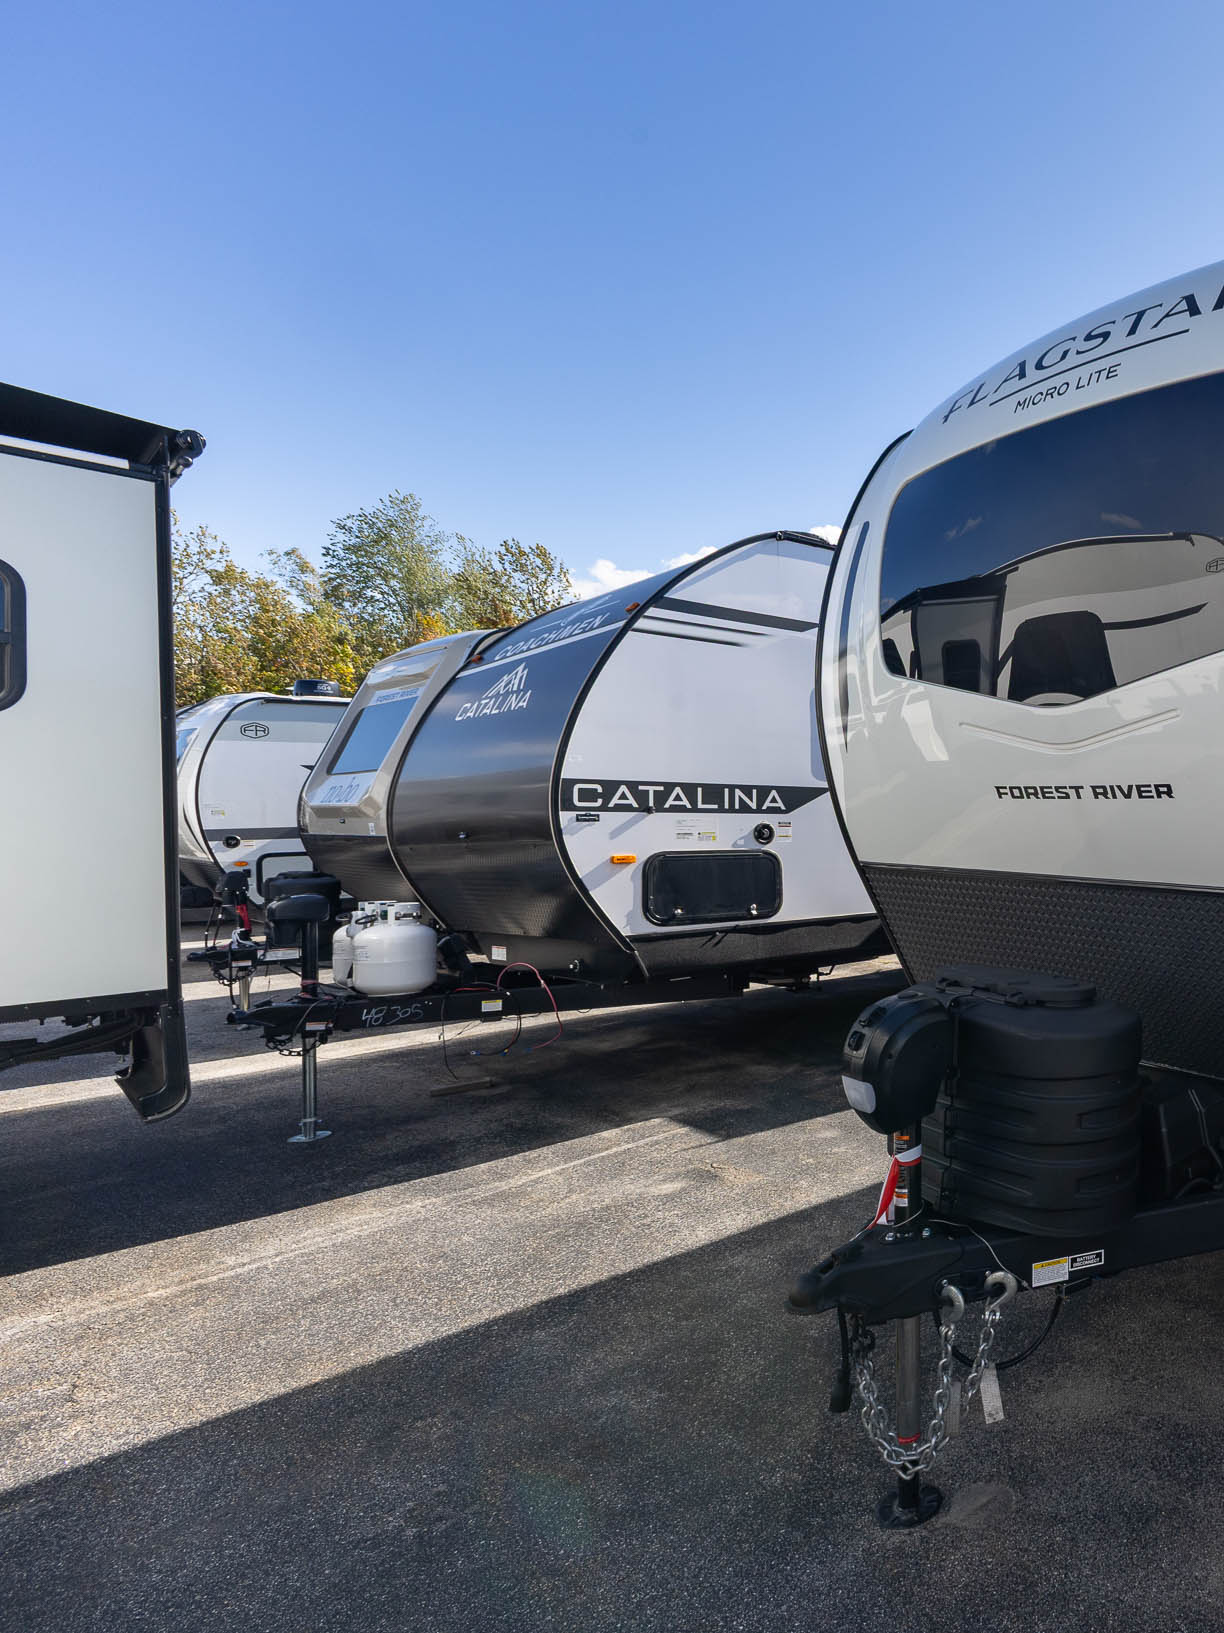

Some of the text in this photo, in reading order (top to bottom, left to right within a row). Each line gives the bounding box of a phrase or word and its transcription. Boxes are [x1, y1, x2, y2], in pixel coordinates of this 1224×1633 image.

[1013, 363, 1122, 414] MICRO LITE
[494, 612, 610, 660] COACHMEN
[455, 690, 532, 721] CATALINA
[572, 783, 787, 810] CATALINA
[994, 783, 1175, 800] FOREST RIVER
